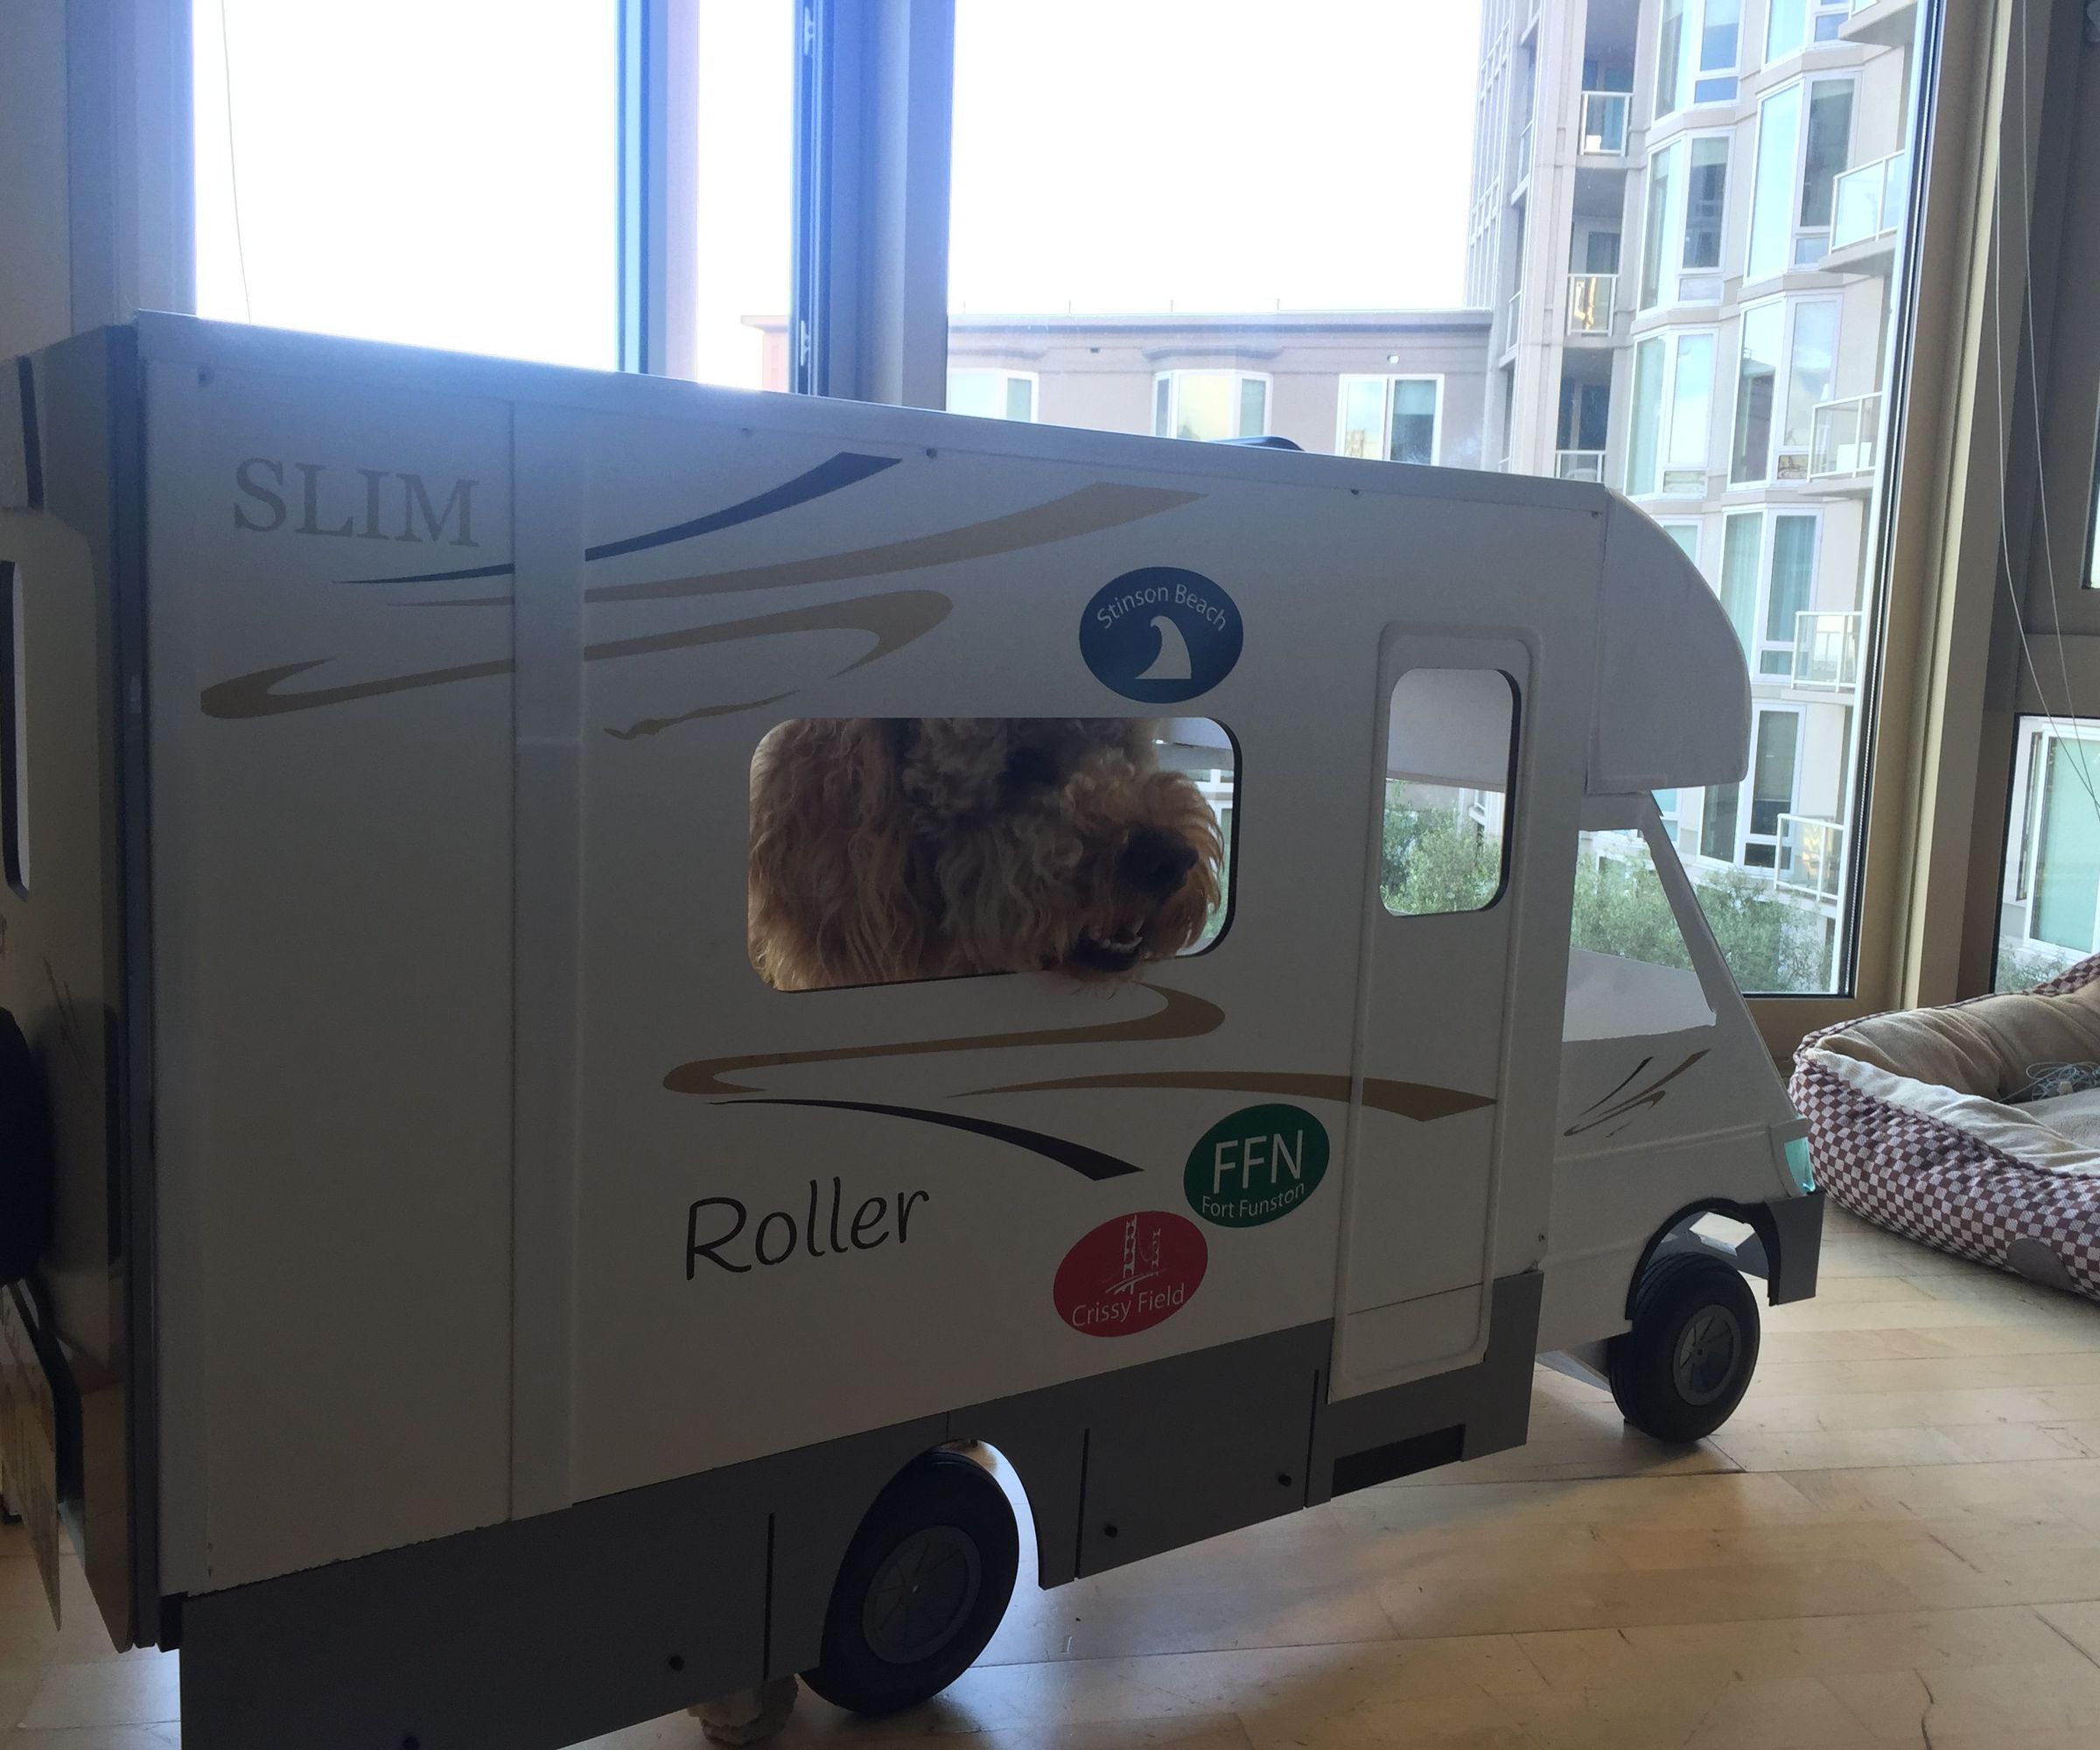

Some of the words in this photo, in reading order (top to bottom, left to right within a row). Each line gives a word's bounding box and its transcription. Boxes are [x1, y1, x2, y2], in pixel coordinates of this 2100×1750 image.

[234, 458, 480, 547] SLIM
[1097, 587, 1169, 629] Stinson
[1174, 584, 1226, 631] Beach
[1214, 1130, 1304, 1194] FFN
[686, 1176, 929, 1280] Roller
[1202, 1195, 1235, 1218] Fort
[1239, 1183, 1305, 1218] Funston
[1072, 1298, 1132, 1327] Crissy
[1138, 1283, 1185, 1313] Field
